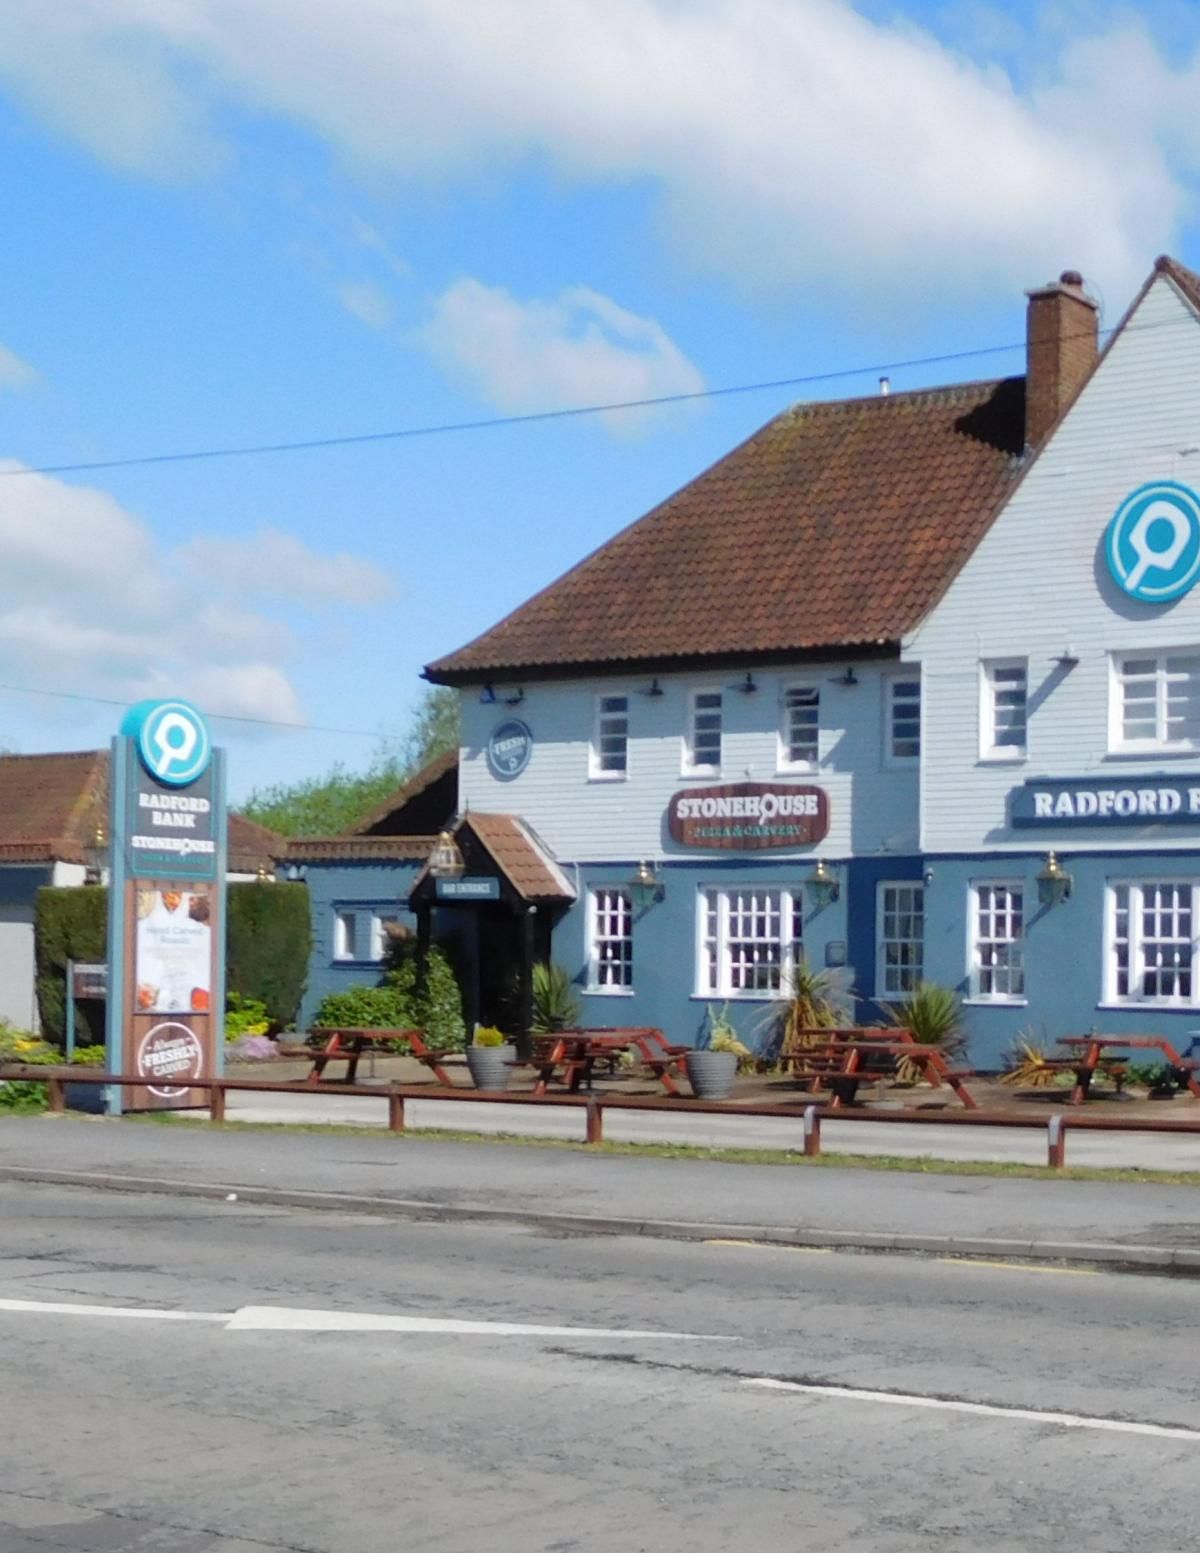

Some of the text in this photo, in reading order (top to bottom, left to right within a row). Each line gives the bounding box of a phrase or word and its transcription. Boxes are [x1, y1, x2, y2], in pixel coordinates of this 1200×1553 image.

[139, 792, 210, 812] RADFORD
[676, 793, 819, 825] STONEHOUSE
[1033, 788, 1181, 818] RADFORD
[152, 811, 196, 828] BANK
